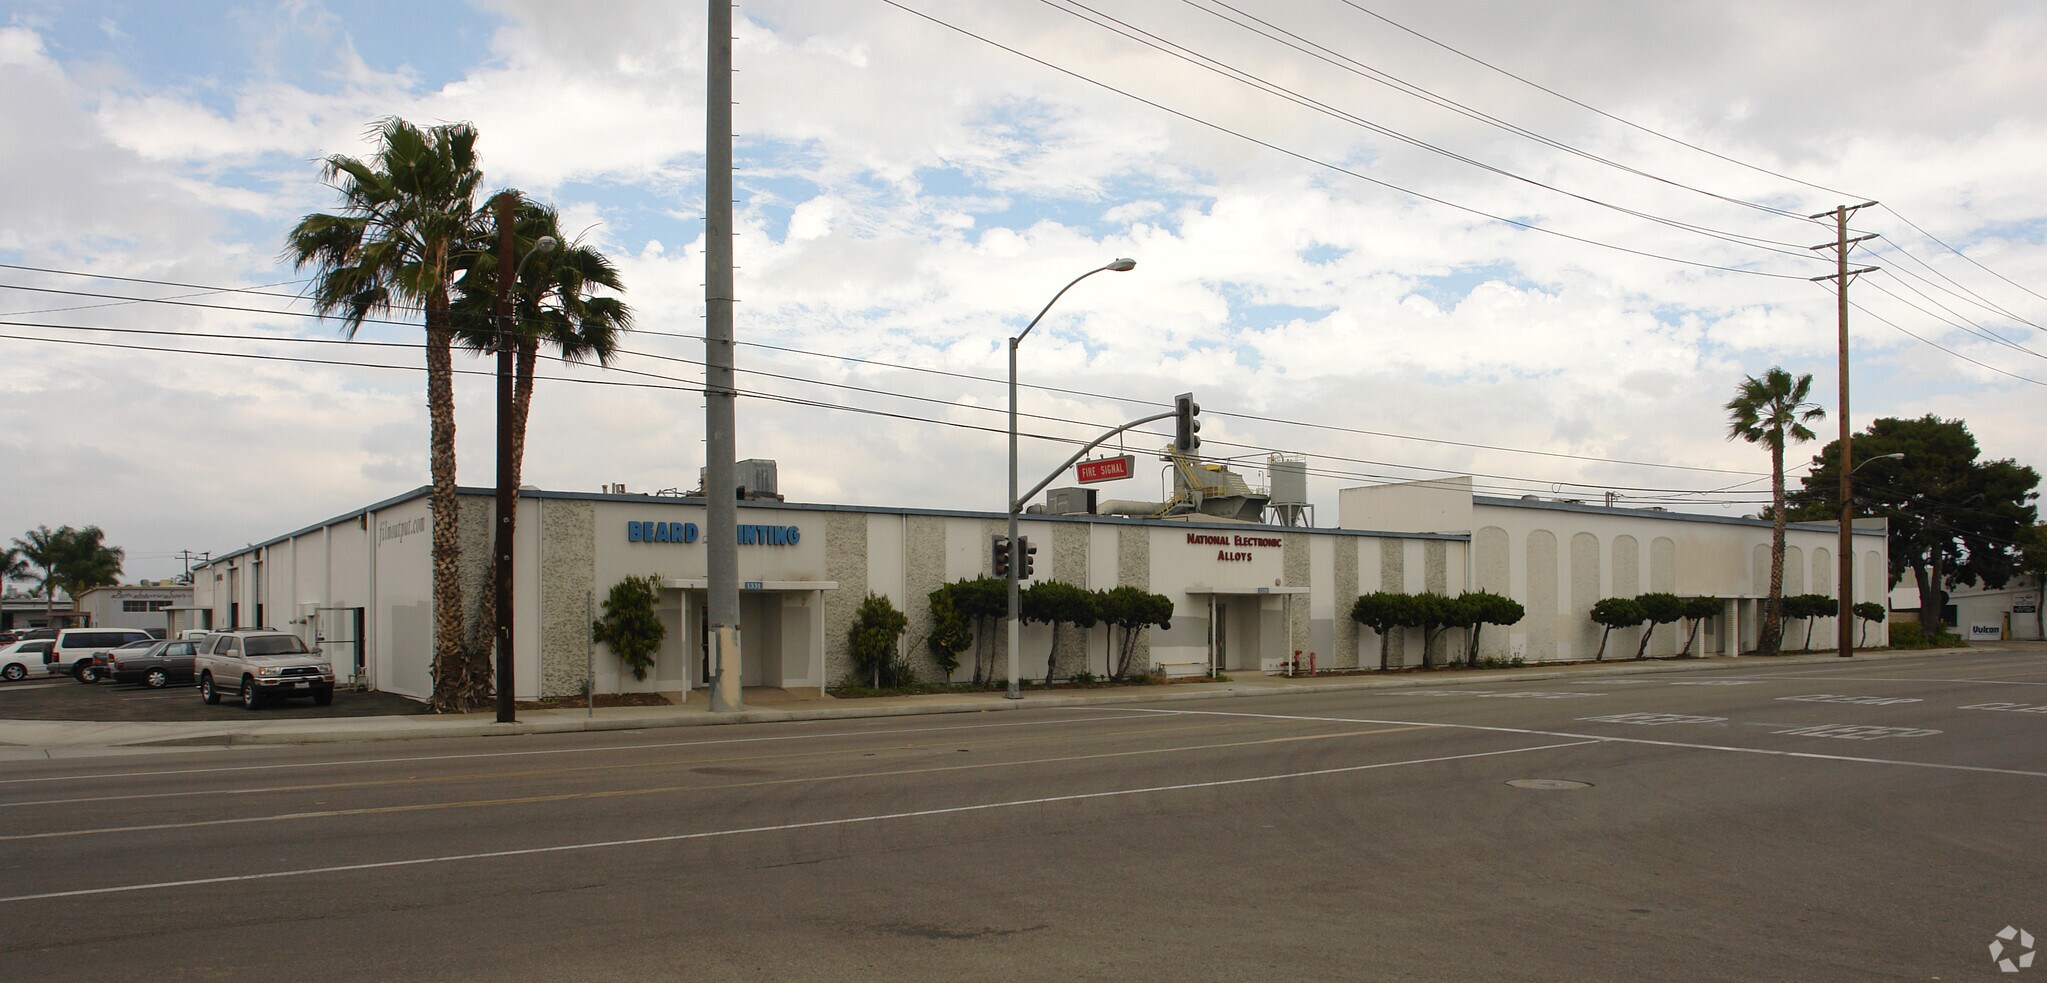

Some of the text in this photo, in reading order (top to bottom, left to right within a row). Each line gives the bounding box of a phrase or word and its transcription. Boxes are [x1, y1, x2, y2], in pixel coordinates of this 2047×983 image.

[1081, 462, 1124, 478] FIRE SIGNAL
[378, 517, 425, 547] filmoutput.com
[628, 520, 801, 546] BEARD INTING
[1187, 532, 1282, 548] NATIONAL ELECTRONIC
[1217, 549, 1252, 562] ALLOYS
[1972, 625, 2000, 634] Vulcan
